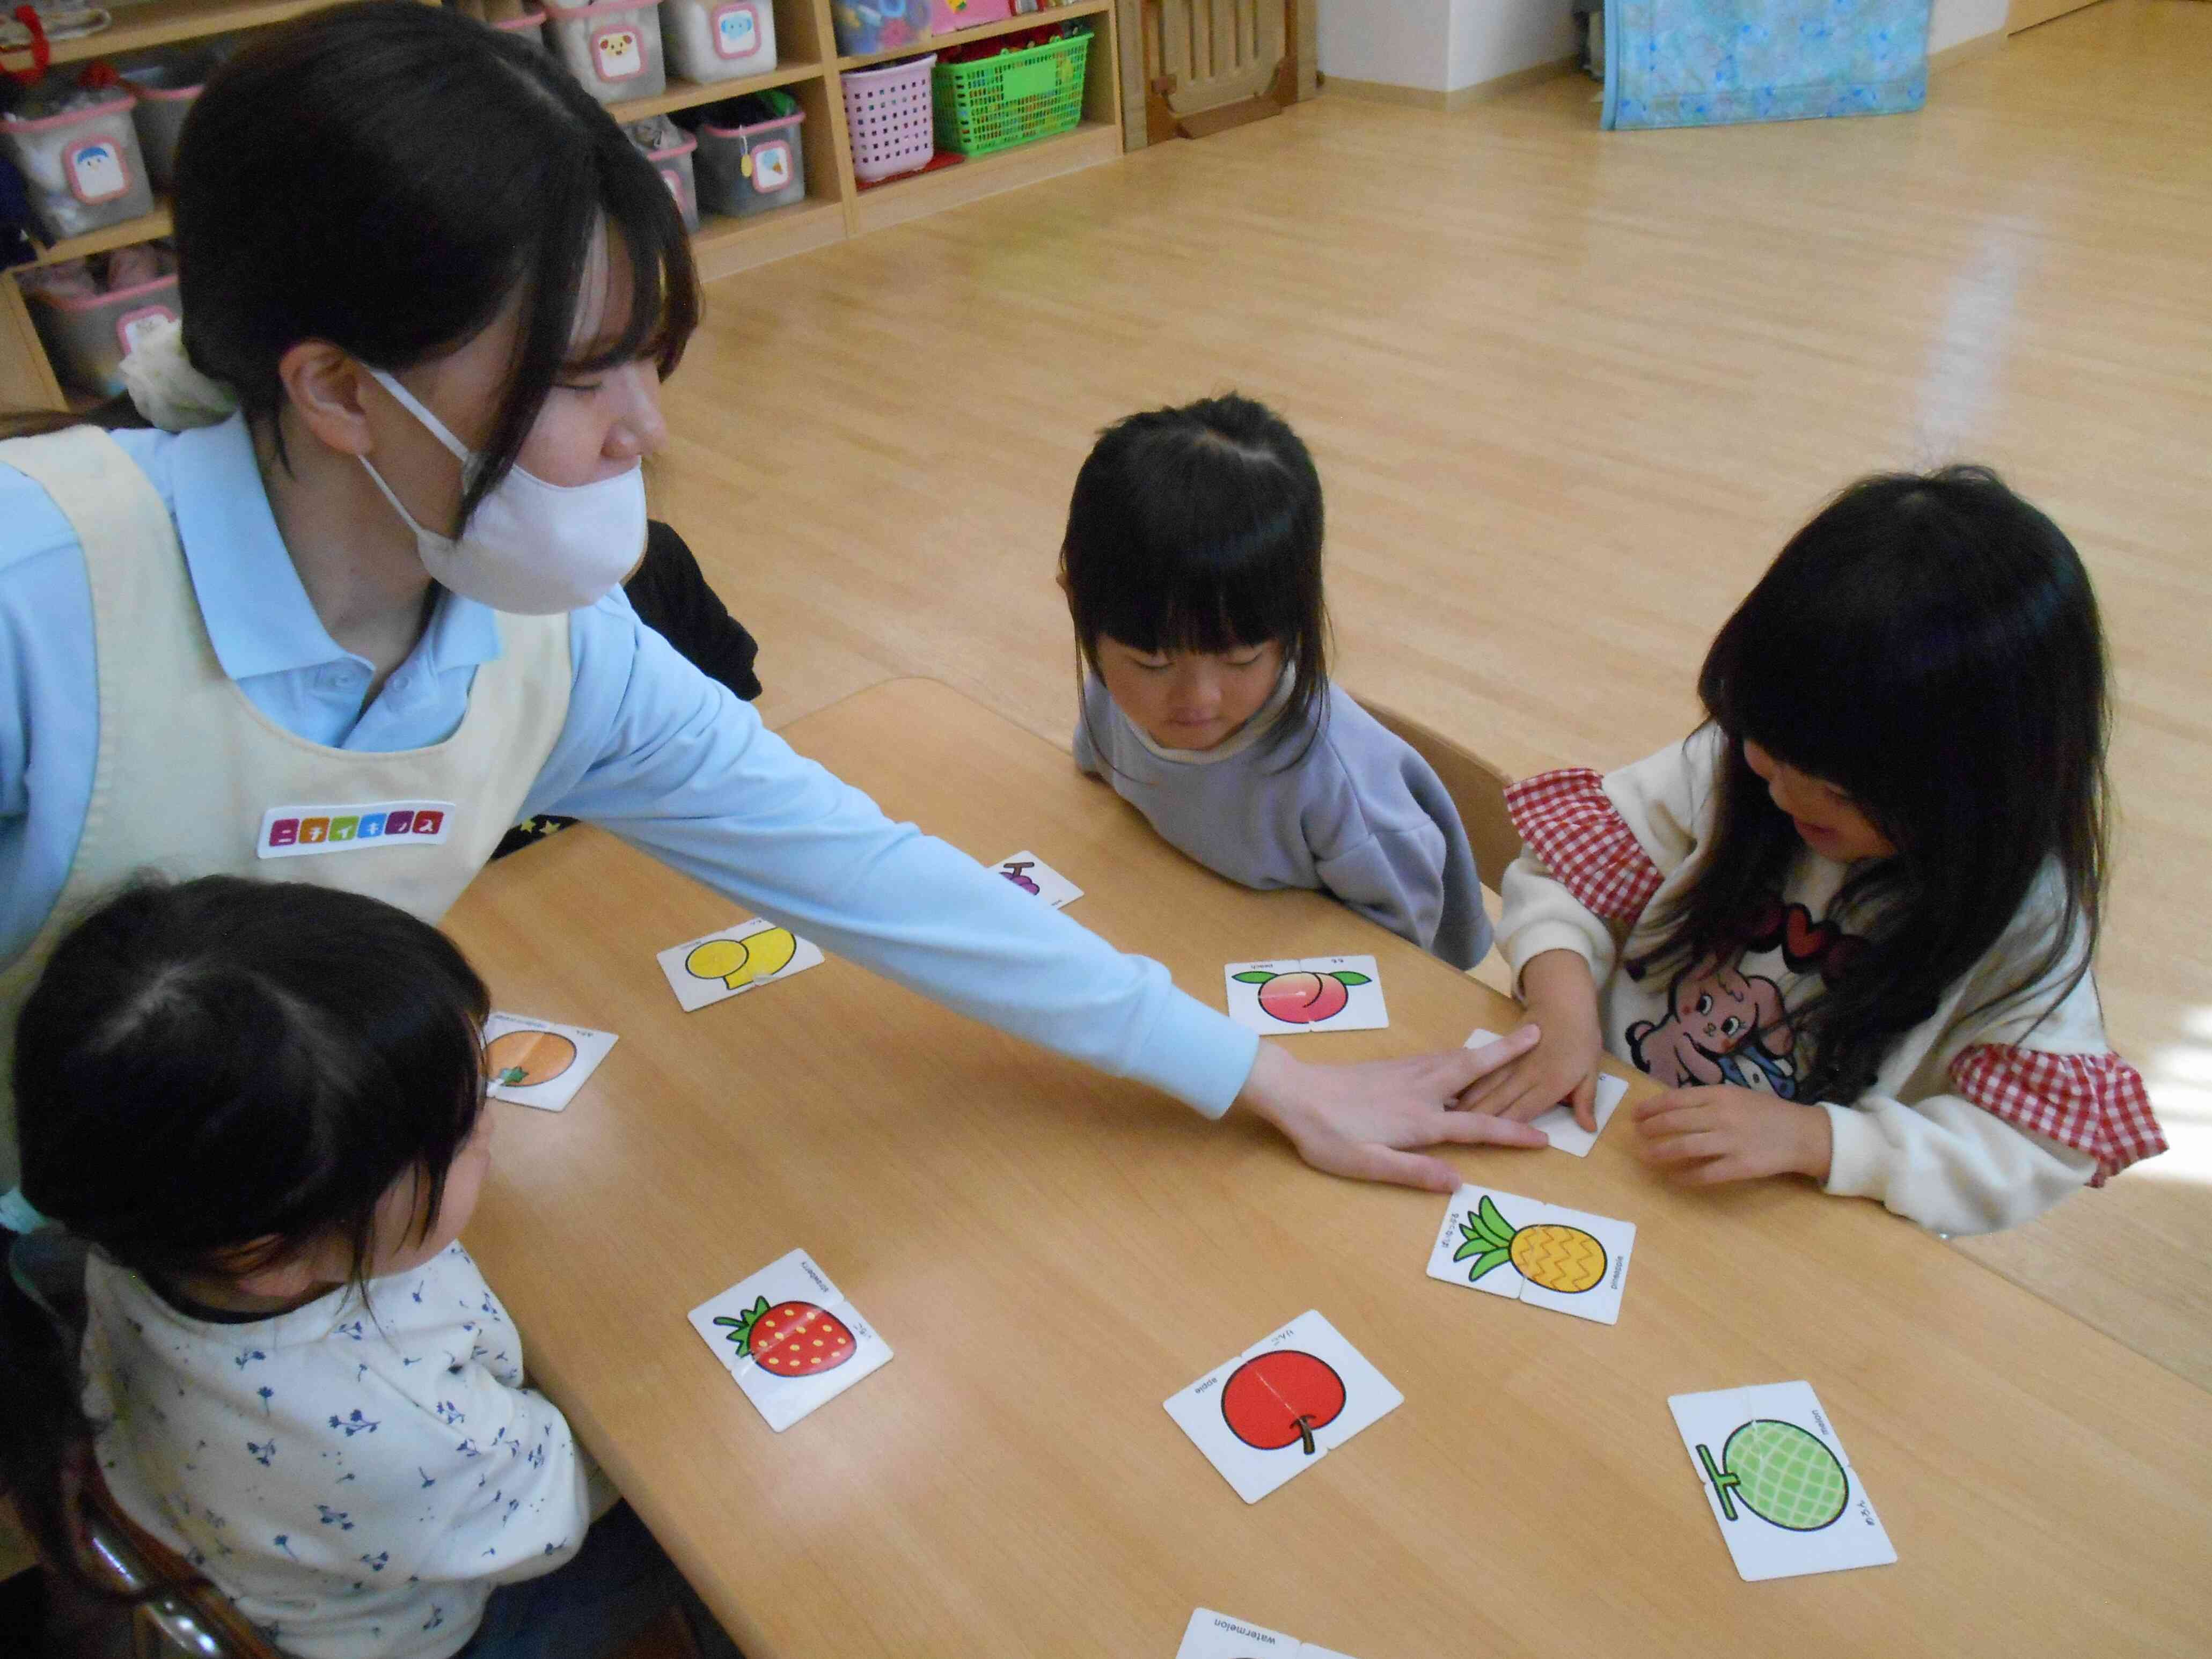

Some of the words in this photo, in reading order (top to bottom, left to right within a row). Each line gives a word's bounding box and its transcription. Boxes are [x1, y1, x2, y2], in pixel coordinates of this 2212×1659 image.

[1195, 1377, 1218, 1394] apple
[1812, 1409, 1829, 1435] melon
[1214, 1618, 1276, 1645] watermelon
